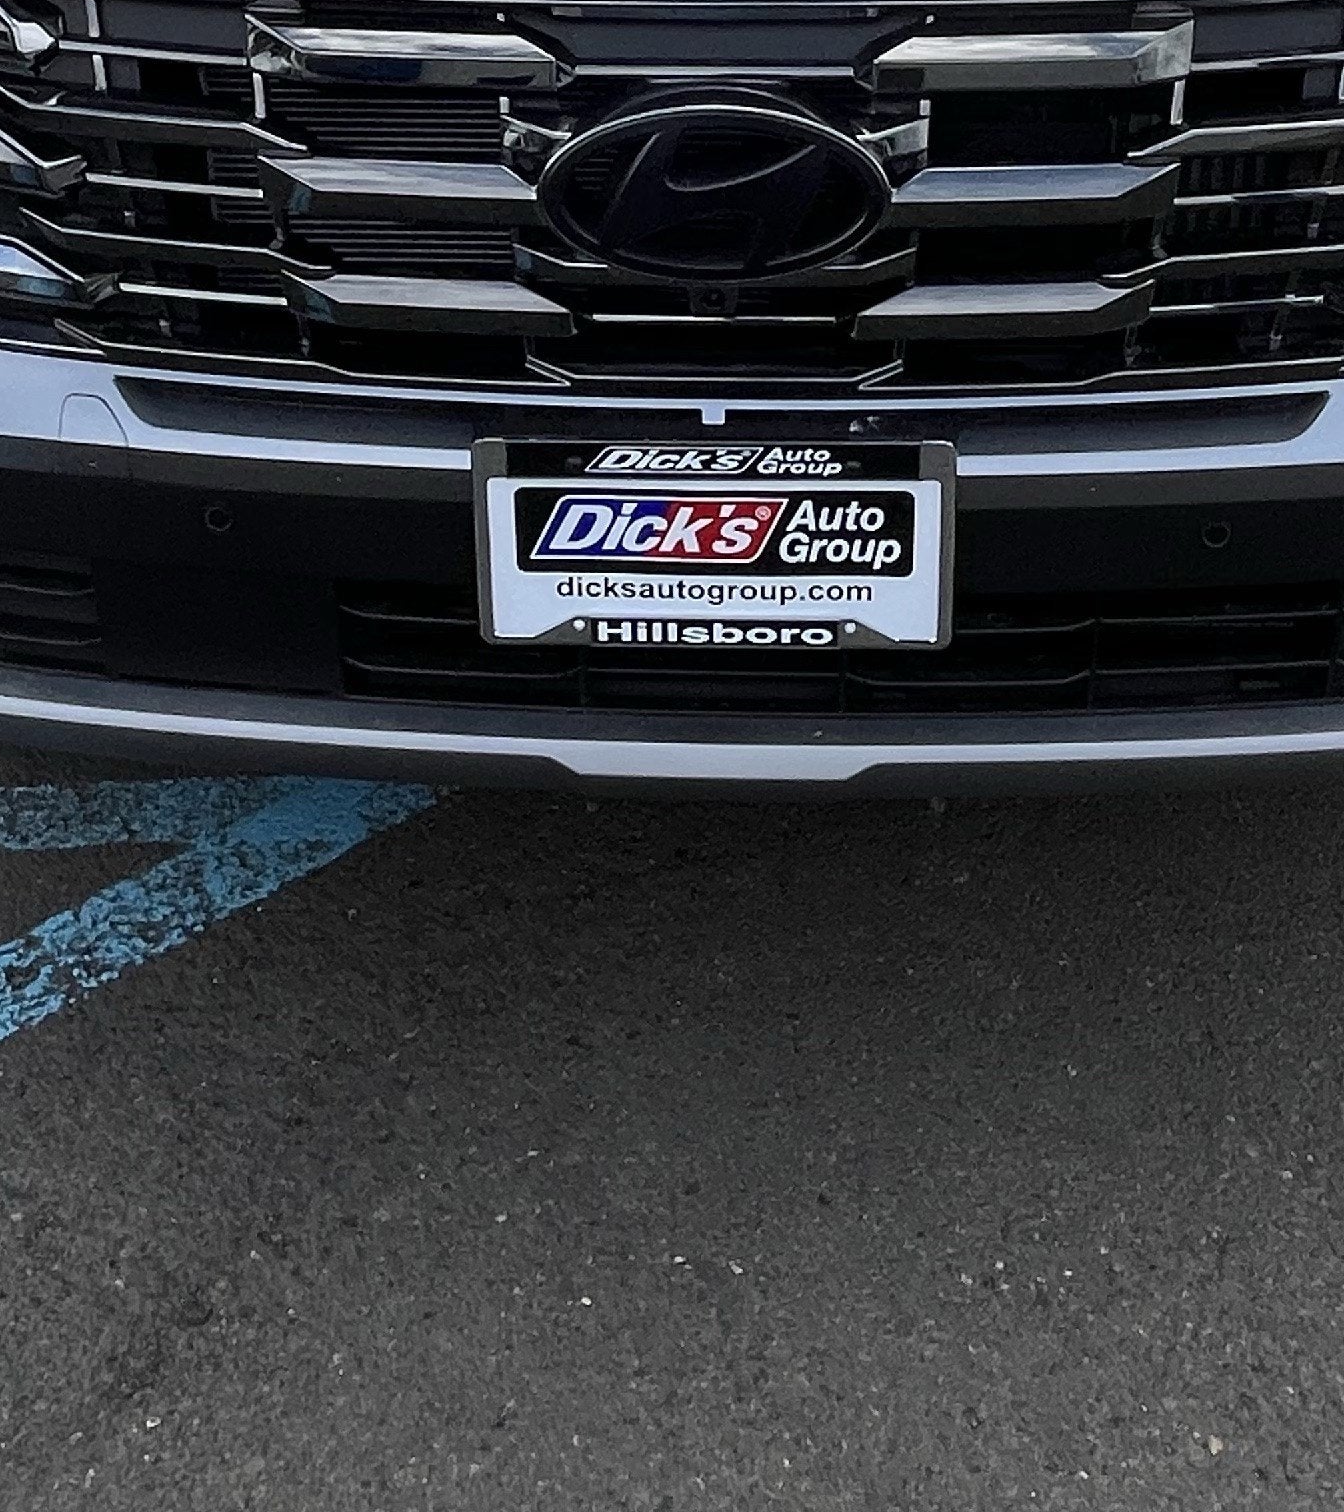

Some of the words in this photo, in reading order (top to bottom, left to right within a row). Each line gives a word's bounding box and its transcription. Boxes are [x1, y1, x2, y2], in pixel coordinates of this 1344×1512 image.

[598, 449, 742, 471] Dick's
[766, 446, 831, 462] Auto
[757, 461, 843, 476] Group
[550, 503, 760, 554] Dick's
[787, 500, 885, 533] Auto
[780, 533, 901, 569] Group
[556, 578, 873, 605] dicksautogroup.com
[597, 621, 834, 645] Hillsboro
